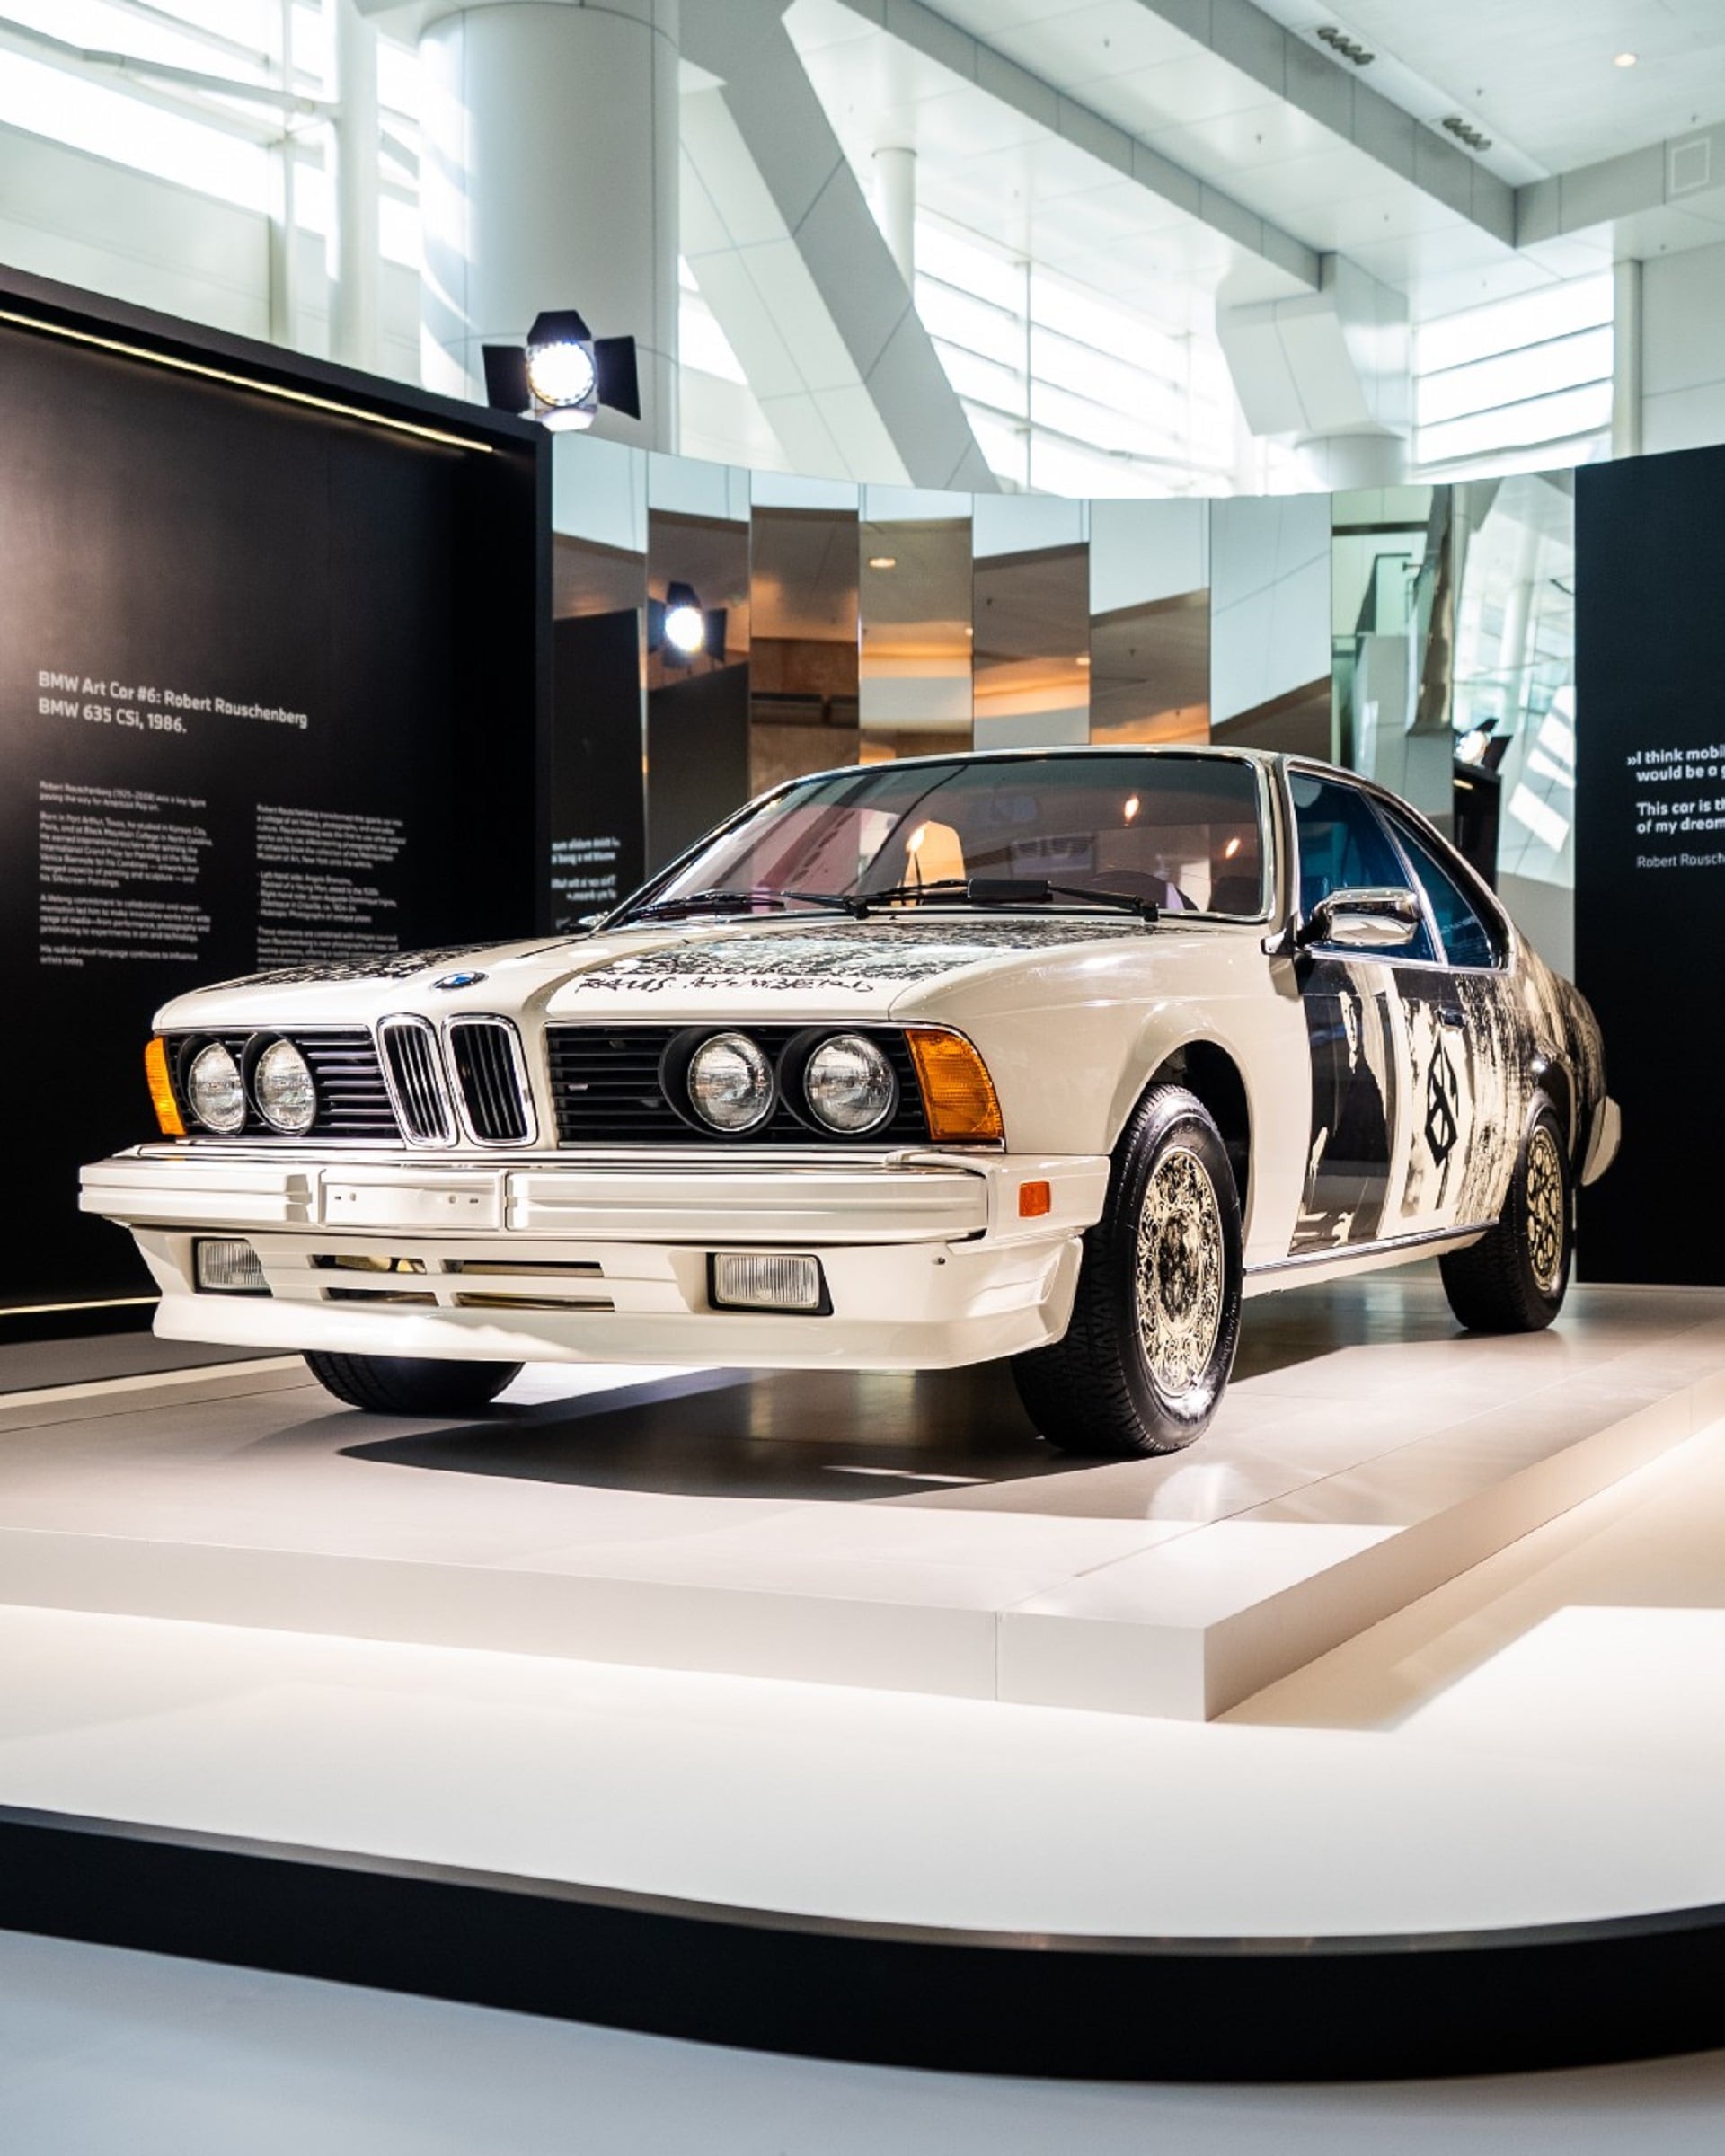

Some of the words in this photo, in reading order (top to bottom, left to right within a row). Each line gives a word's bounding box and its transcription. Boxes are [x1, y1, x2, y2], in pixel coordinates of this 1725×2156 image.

[39, 671, 77, 693] BMW
[82, 677, 106, 696] Art
[110, 681, 134, 700] Car
[137, 685, 162, 704] #6:
[164, 690, 211, 712] Robert
[215, 698, 308, 729] Rauschenberg
[39, 698, 78, 719] BMW
[82, 704, 111, 723] 635
[116, 709, 144, 730] CSi,
[146, 713, 187, 734] 1986.
[1645, 747, 1683, 764] think
[1636, 765, 1682, 782] would
[1685, 765, 1704, 779] be
[1707, 765, 1718, 777] a
[1636, 800, 1668, 816] This
[1671, 801, 1695, 815] car
[1699, 798, 1712, 812] is
[1636, 819, 1651, 834] of
[1655, 820, 1677, 835] my
[1636, 855, 1677, 868] Robert
